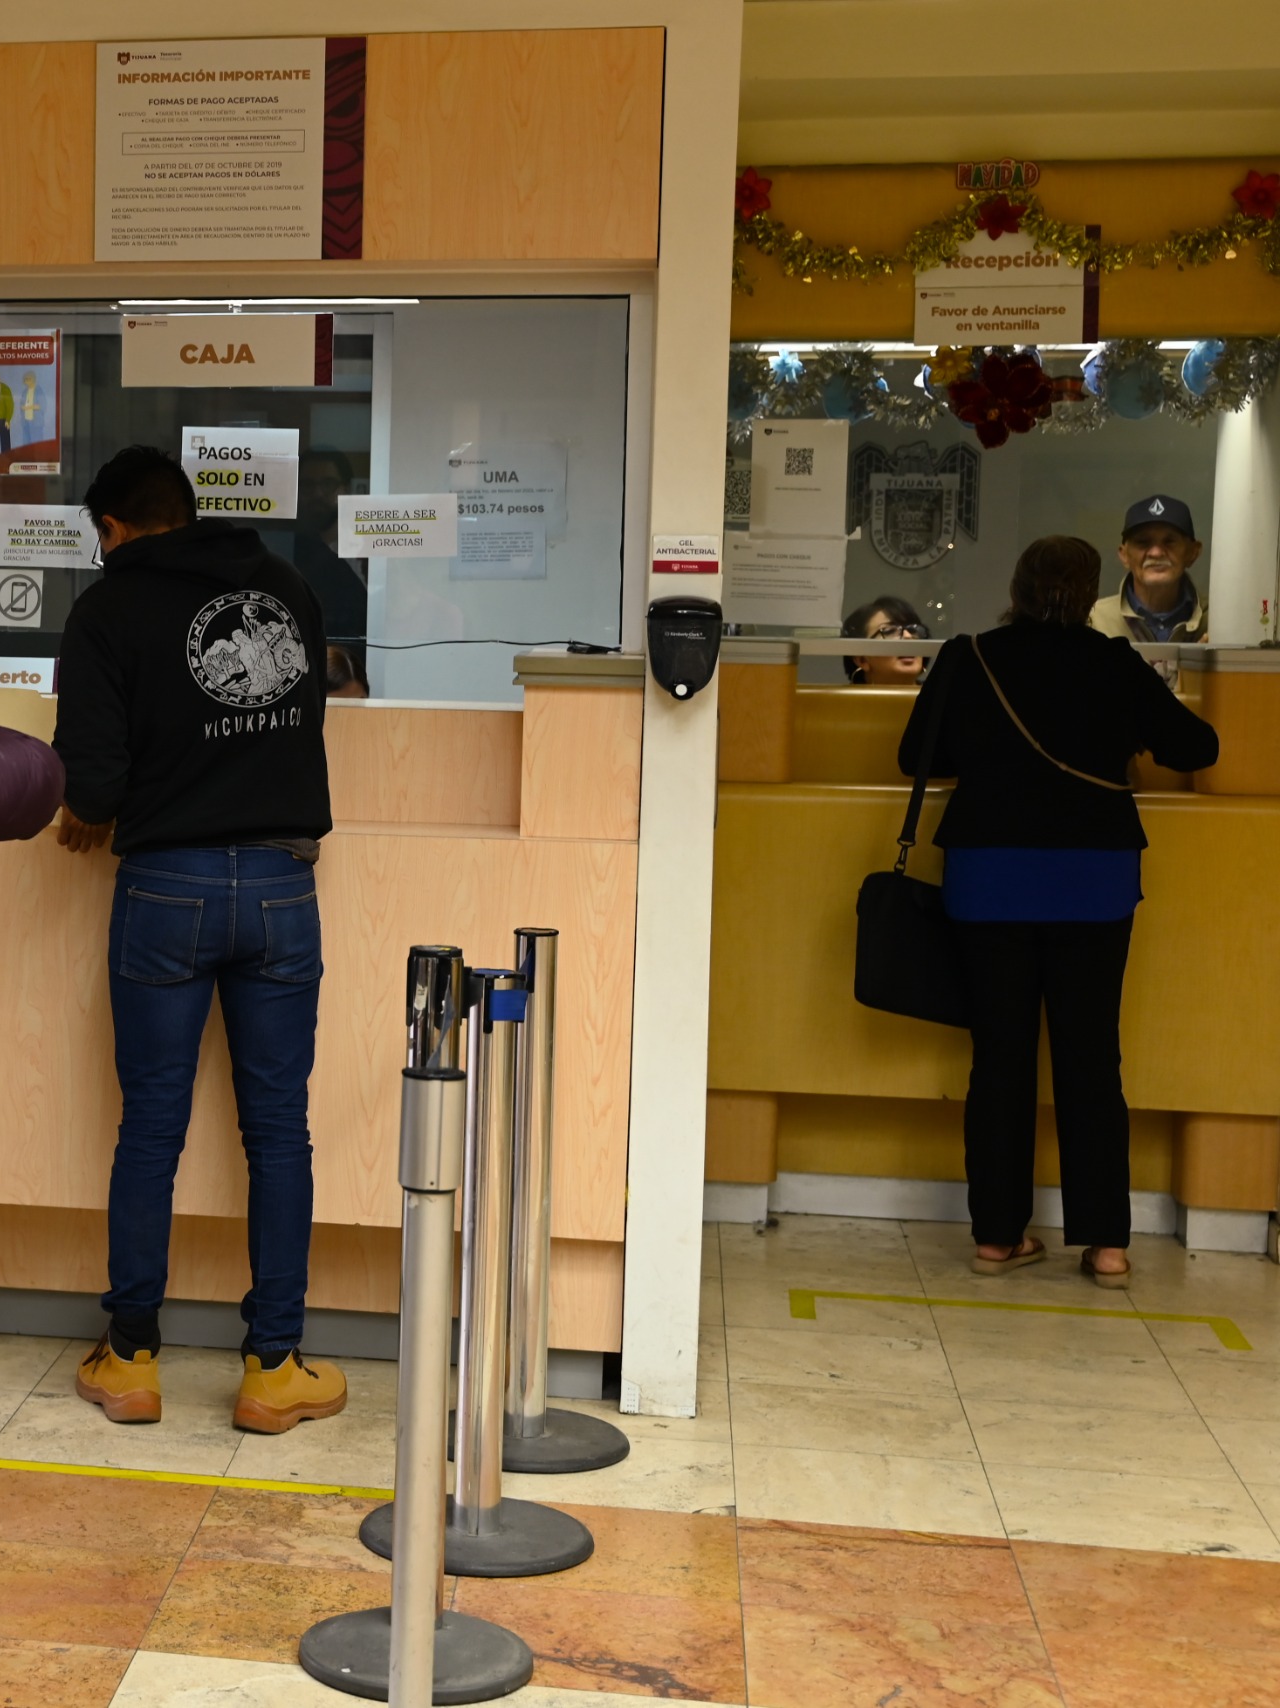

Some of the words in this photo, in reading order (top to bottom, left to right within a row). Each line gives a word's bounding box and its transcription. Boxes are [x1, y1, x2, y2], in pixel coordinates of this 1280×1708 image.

[117, 69, 216, 84] INFORMACIÓN
[219, 69, 311, 82] IMPORTANTE
[148, 98, 185, 106] FORMAS
[187, 97, 199, 105] DE
[201, 97, 225, 105] PAGO
[227, 96, 279, 104] ACEPTADAS
[217, 161, 253, 169] OCTUBRE
[168, 171, 203, 179] ACEPTAN
[245, 169, 281, 178] DÓLARES
[957, 159, 1040, 189] NAVIDAD
[931, 306, 968, 317] Favor
[971, 305, 989, 316] de
[992, 304, 1066, 316] Anunciarse
[956, 321, 972, 331] en
[976, 319, 1040, 331] ventanilla
[180, 344, 256, 365] CAJA
[198, 446, 252, 461] PAGOS
[197, 472, 239, 486] SOLO
[244, 472, 265, 486] EN
[483, 471, 520, 483] UMA
[887, 479, 943, 487] TIJUANA
[197, 496, 271, 512] EFECTIVO
[458, 502, 504, 515] $103.74
[507, 504, 545, 515] pesos
[355, 510, 400, 519] ESPERE
[402, 510, 411, 518] A
[413, 509, 436, 518] SER
[24, 519, 52, 527] FAVOR
[54, 519, 65, 527] DE
[355, 523, 420, 533] LLAMADO...
[873, 529, 920, 566] EMPIEZA
[929, 546, 945, 559] LA
[943, 489, 953, 535] PATRIA
[8, 528, 35, 536] PAGAR
[37, 528, 55, 536] CON
[57, 529, 81, 537] FERIA
[43, 538, 78, 547] CAMBIO.
[372, 537, 423, 549] ¡GRACIAS!
